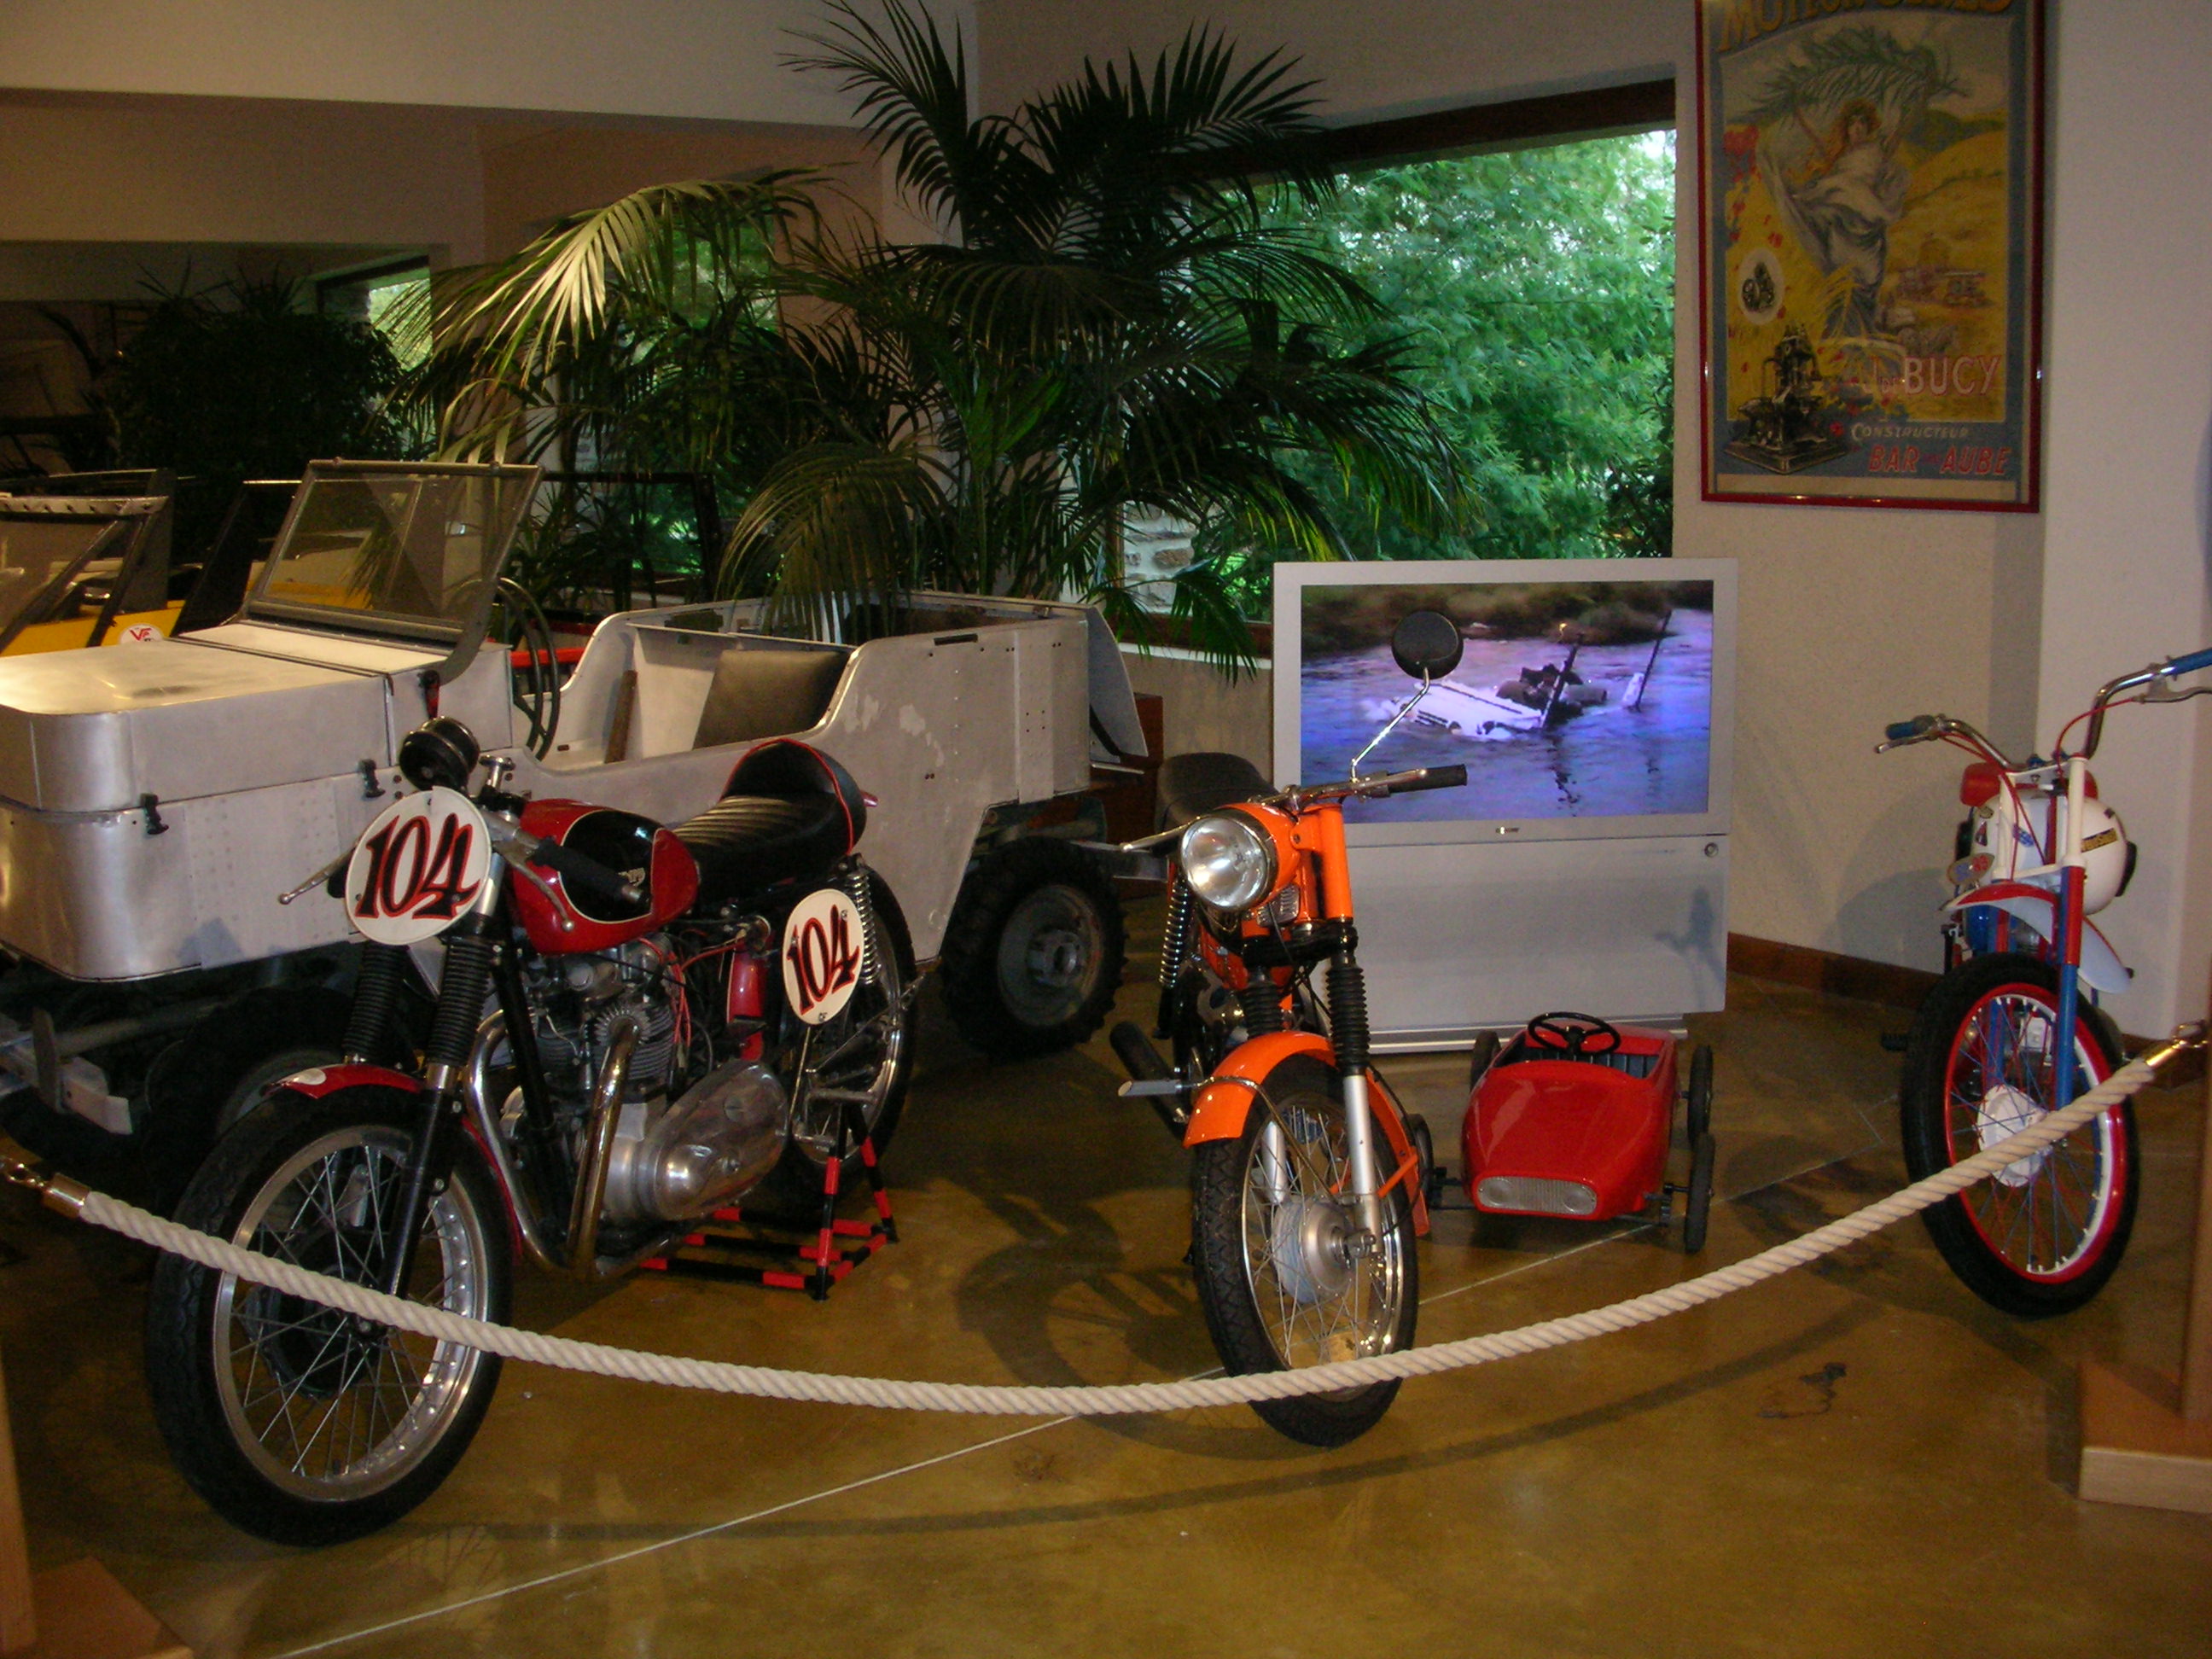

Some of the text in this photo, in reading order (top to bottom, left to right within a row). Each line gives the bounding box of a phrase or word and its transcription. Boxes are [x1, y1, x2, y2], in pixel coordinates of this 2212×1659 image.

[1904, 355, 2001, 397] BUCY
[354, 812, 480, 921] 104
[787, 904, 860, 1016] 104
